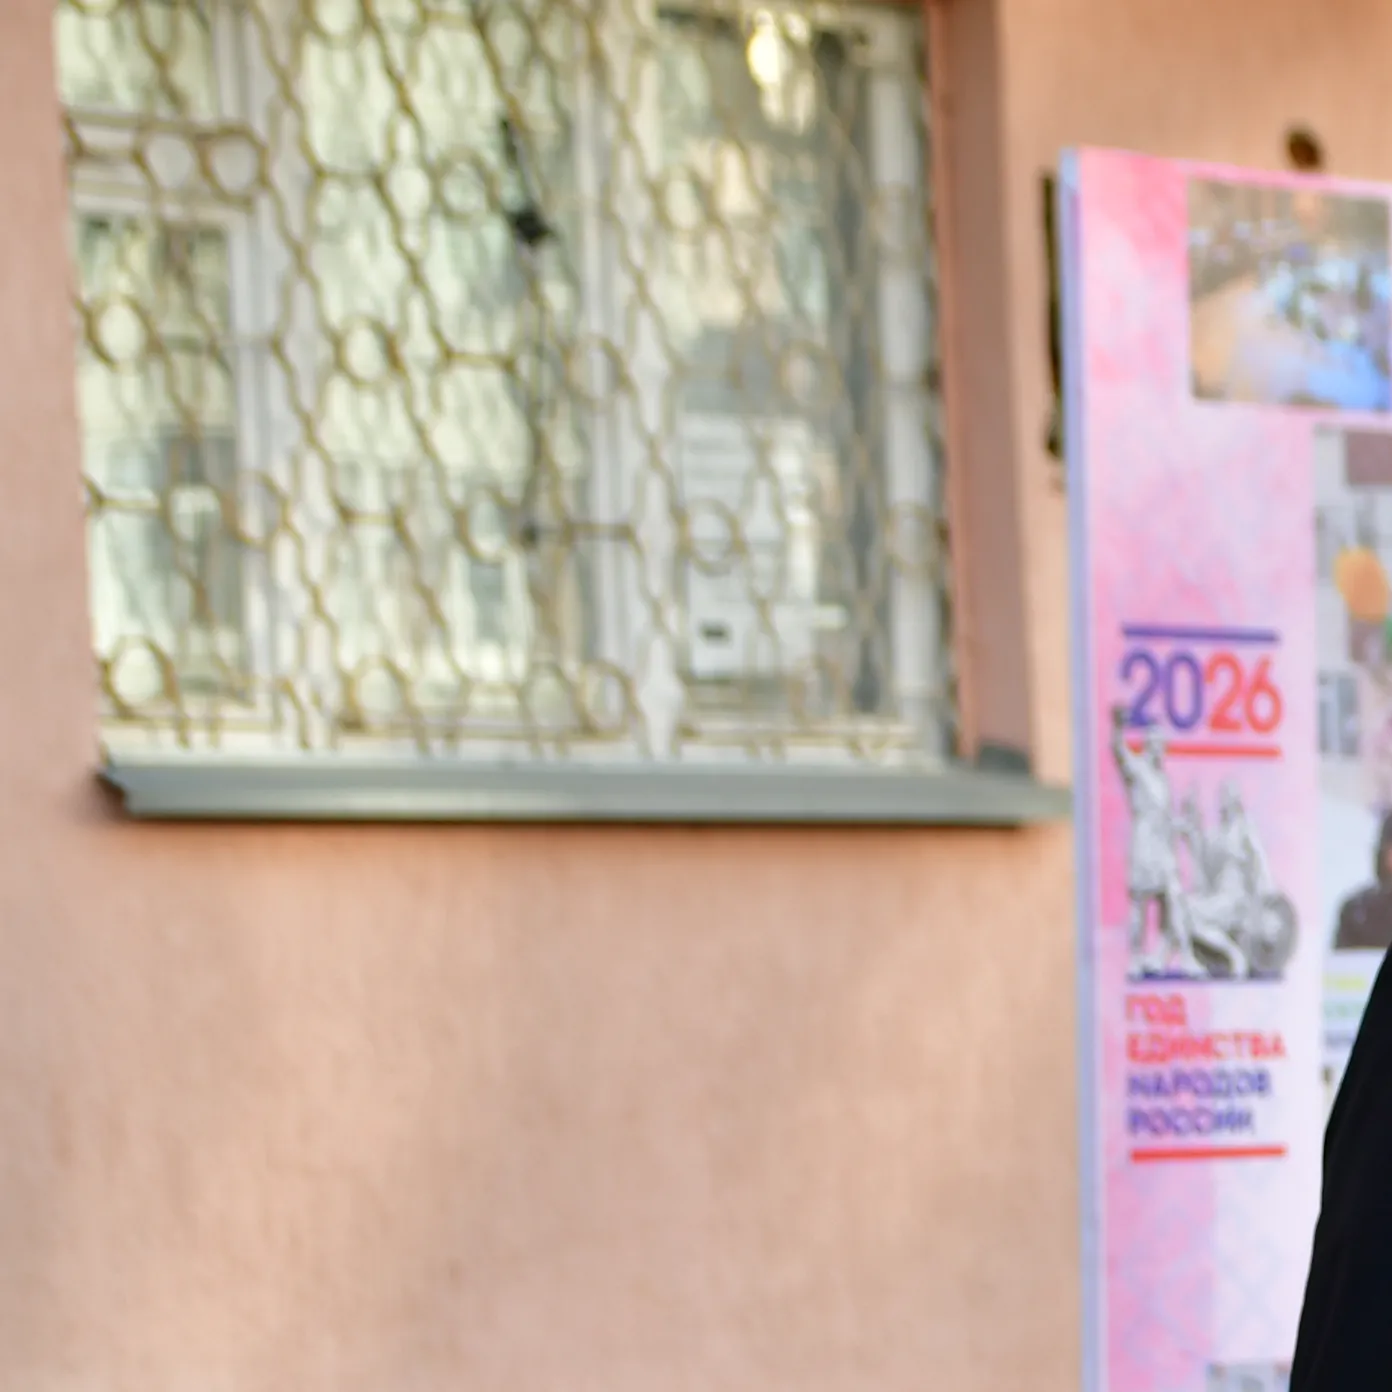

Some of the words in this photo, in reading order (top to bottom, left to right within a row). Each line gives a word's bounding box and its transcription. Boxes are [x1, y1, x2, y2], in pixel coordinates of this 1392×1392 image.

[1121, 650, 1283, 732] 2026
[1126, 994, 1186, 1025] ГОД
[1127, 1031, 1286, 1063] ЕДИНСТВА
[1128, 1069, 1272, 1099] НАРОДОВ
[1128, 1107, 1255, 1136] РОССИИ
